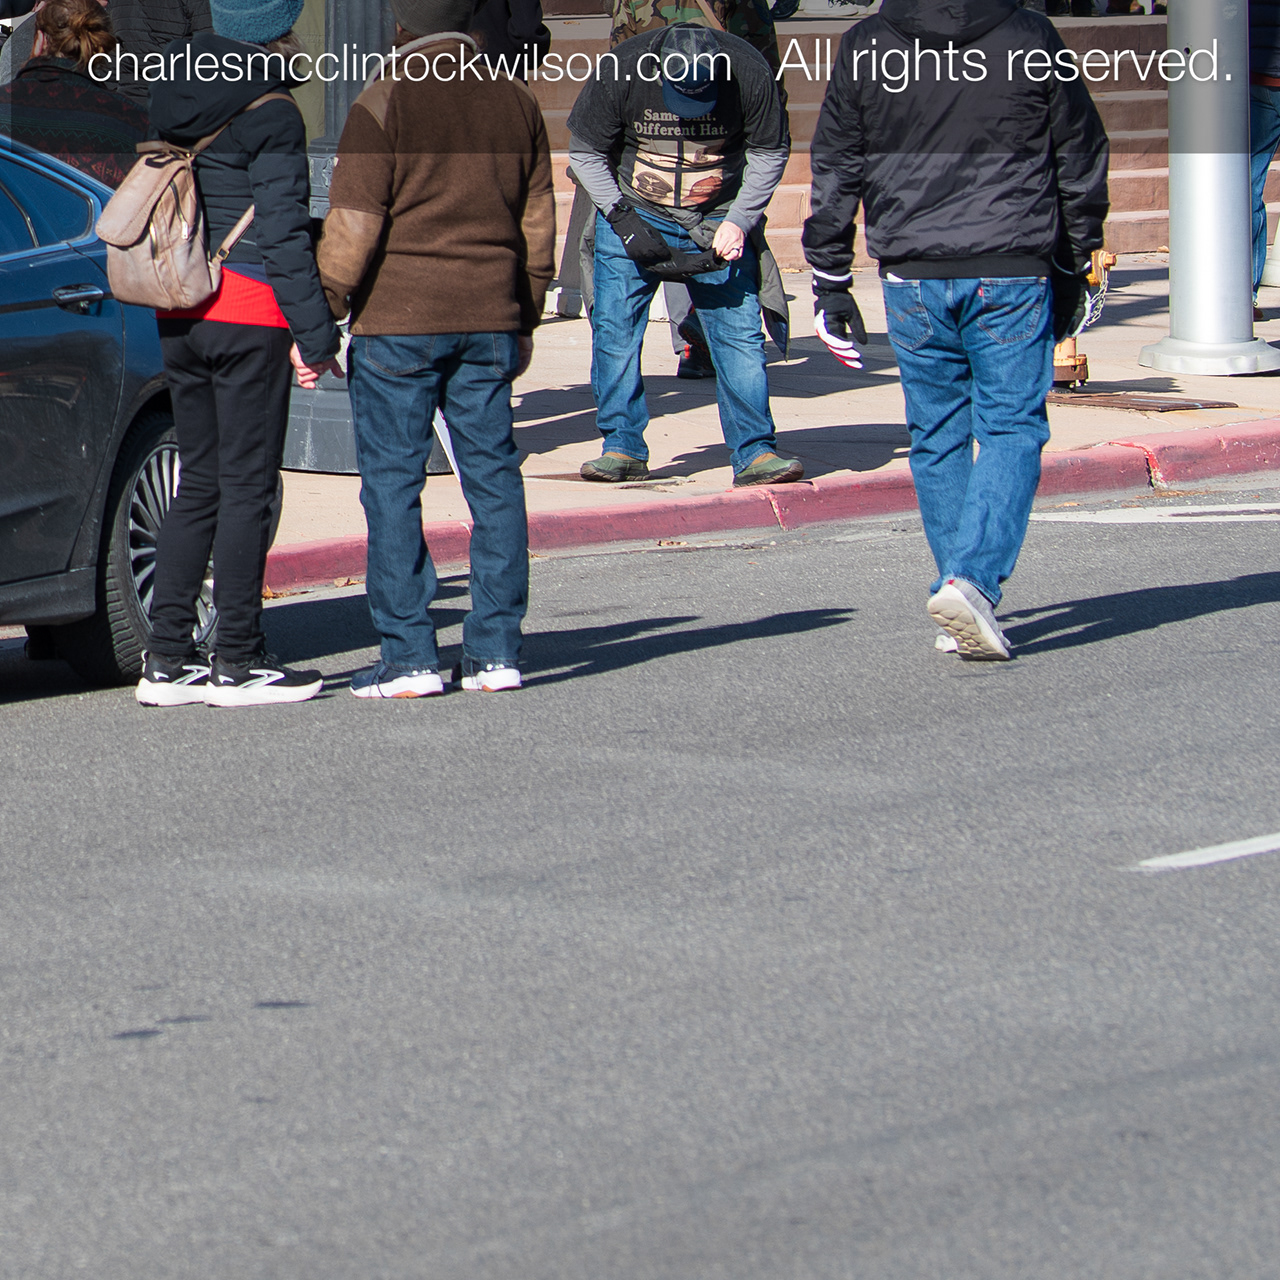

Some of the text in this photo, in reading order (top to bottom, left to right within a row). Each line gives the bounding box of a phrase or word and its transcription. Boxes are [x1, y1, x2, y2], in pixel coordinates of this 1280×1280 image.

[644, 109, 680, 122] Same
[634, 122, 728, 136] Different Hat.
